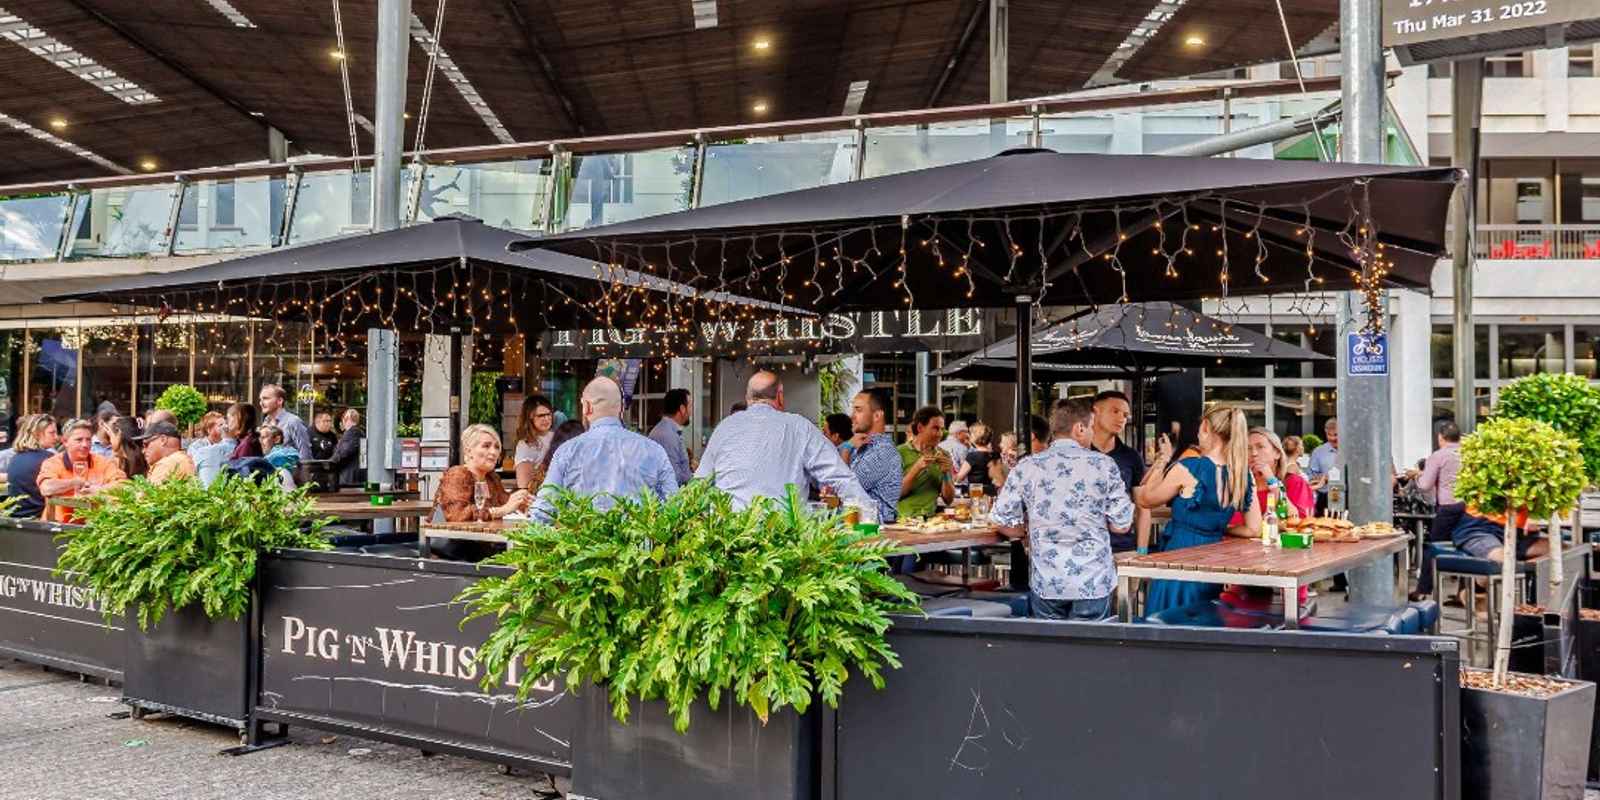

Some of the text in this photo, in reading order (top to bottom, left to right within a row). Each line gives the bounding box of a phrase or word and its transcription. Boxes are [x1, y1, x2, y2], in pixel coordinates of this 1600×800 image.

[1393, 0, 1547, 34] Thu Mar 31 2022
[0, 575, 17, 598] IG
[281, 616, 340, 660] PIG
[375, 627, 555, 692] WHISL
